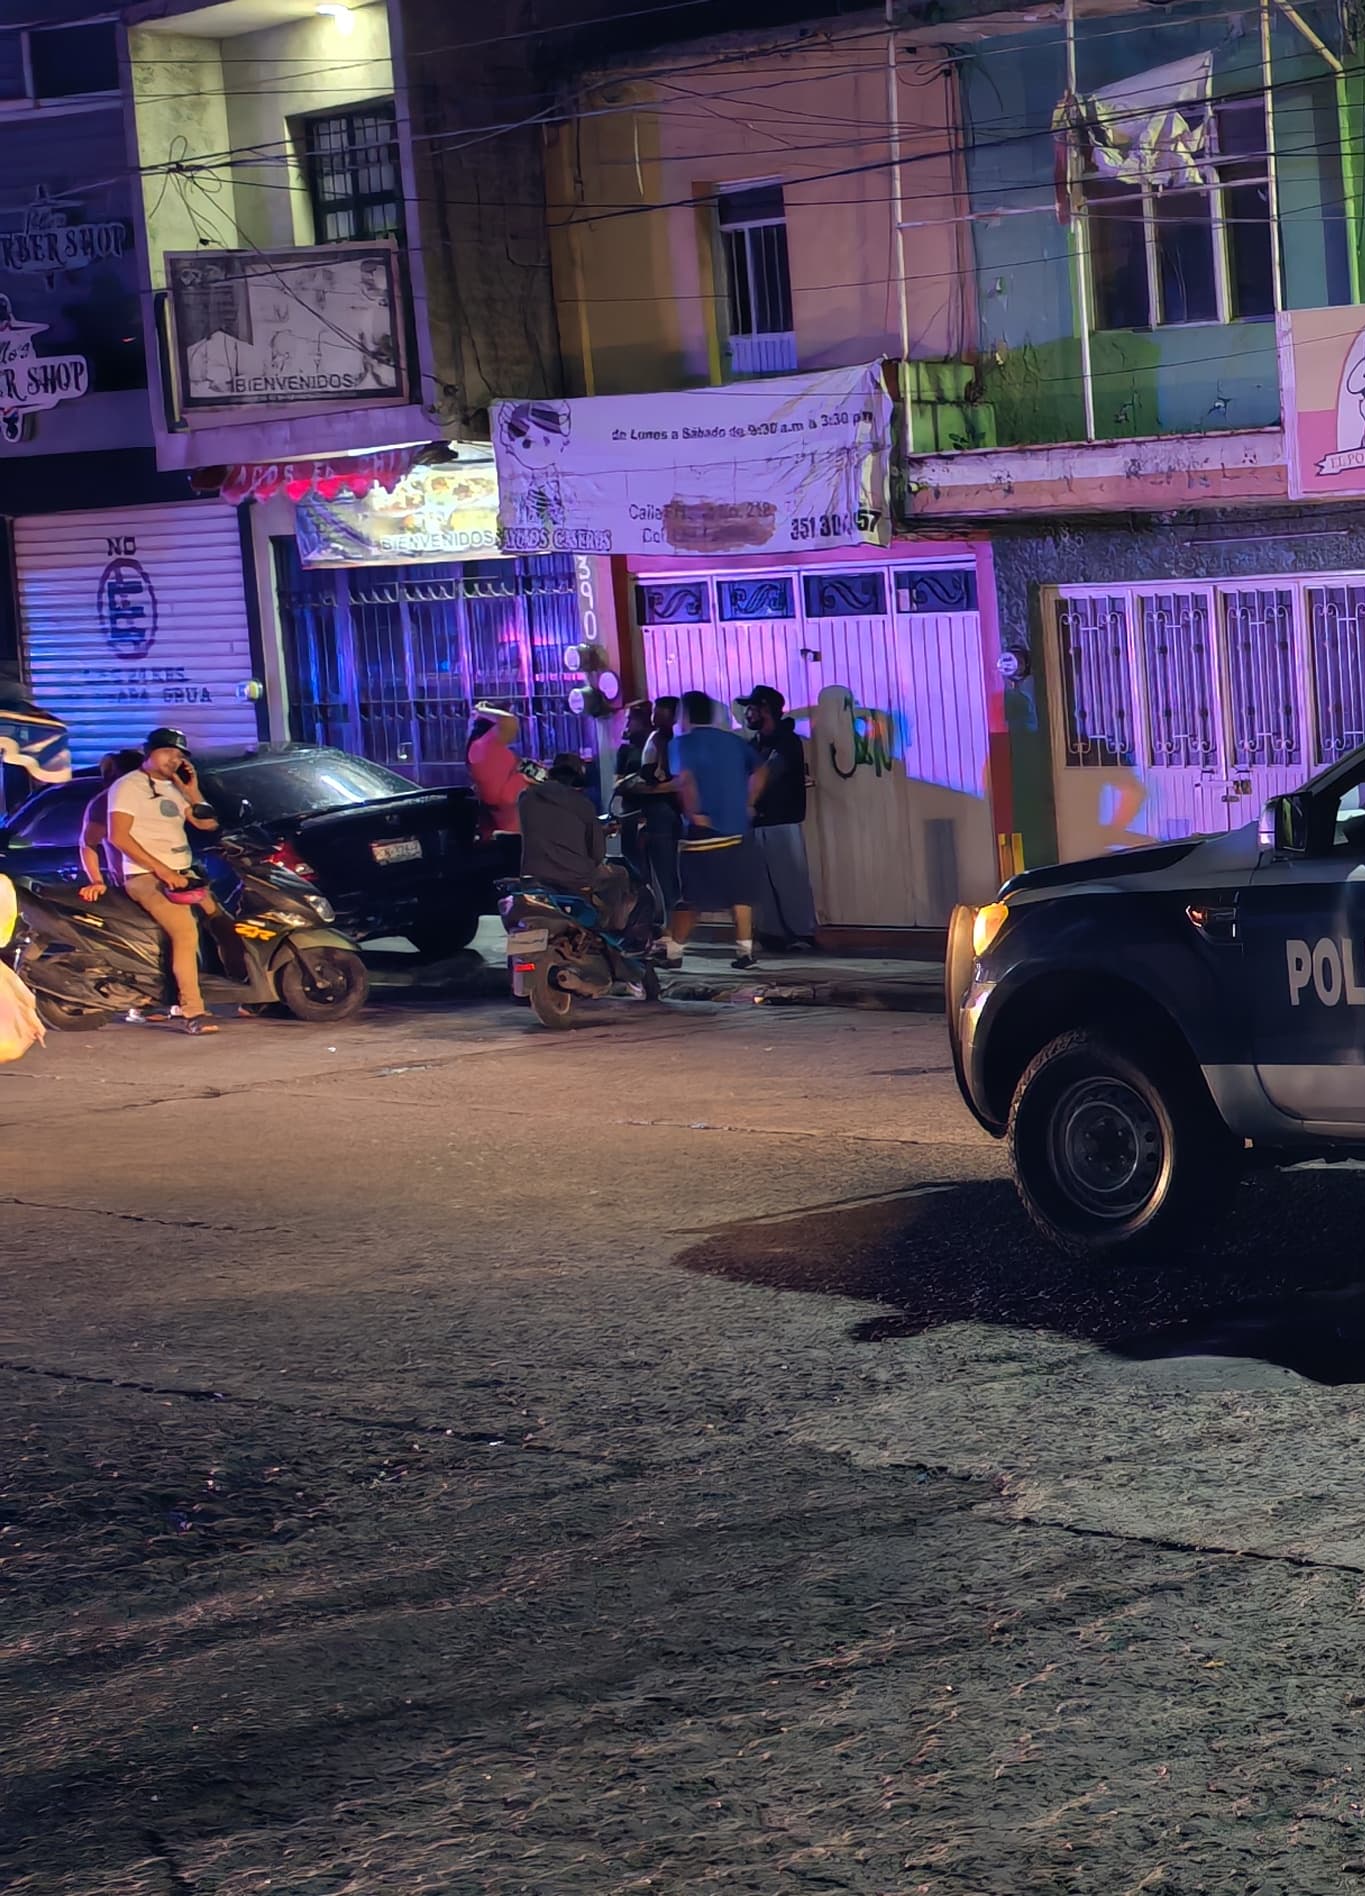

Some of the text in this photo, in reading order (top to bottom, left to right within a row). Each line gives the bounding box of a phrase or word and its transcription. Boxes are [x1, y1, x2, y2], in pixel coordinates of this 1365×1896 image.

[27, 360, 85, 396] SHOP
[234, 373, 353, 394] BIENVENIDOS
[106, 535, 137, 557] NO
[381, 529, 497, 551] BIENVENIDOS
